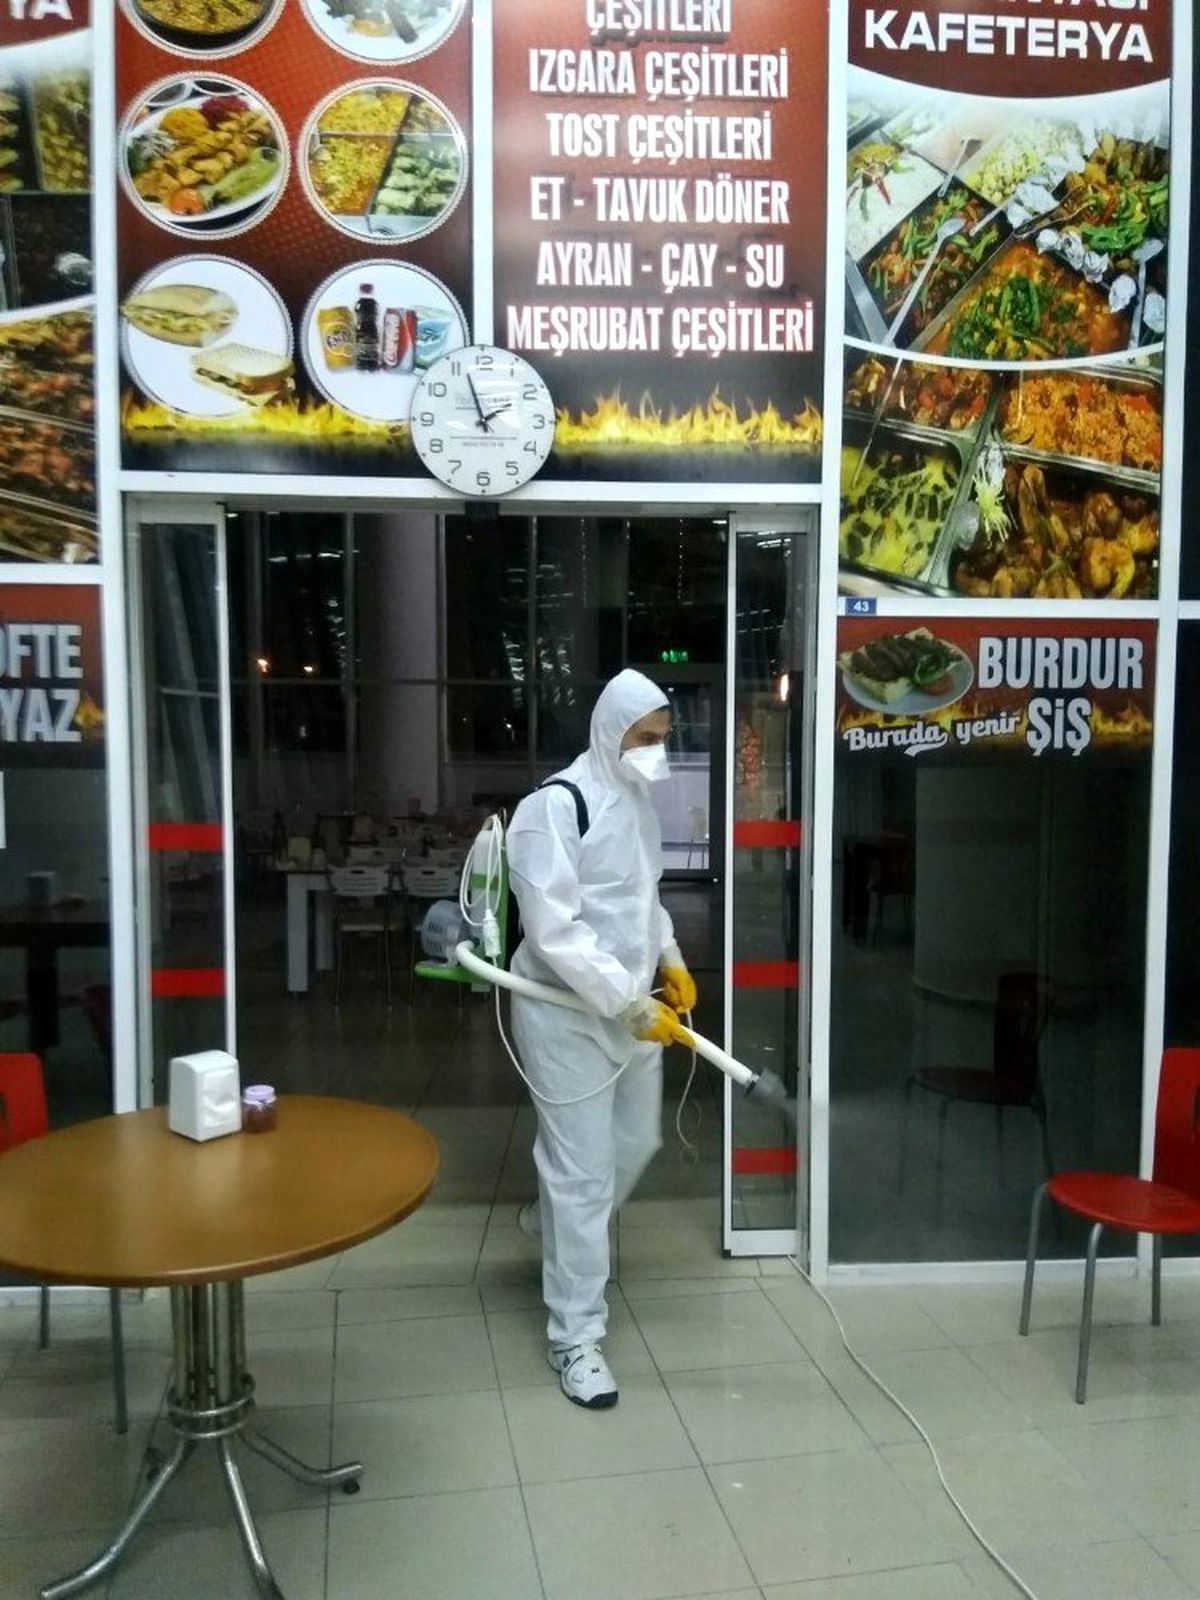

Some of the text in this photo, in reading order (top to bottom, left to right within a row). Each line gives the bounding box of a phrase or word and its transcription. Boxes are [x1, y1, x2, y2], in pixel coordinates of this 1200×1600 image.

[865, 9, 1154, 63] KAFETERYA
[529, 46, 789, 102] IZGARA ÇEŞİTLERİ
[546, 108, 772, 165] TOST ÇEŞİTLERİ
[530, 177, 565, 221] ET
[592, 178, 688, 223] TAVUK
[695, 173, 791, 225] DÖNER
[536, 242, 633, 286] AYRAN
[661, 243, 718, 294] ÇAY
[745, 244, 785, 289] SU
[507, 300, 814, 358] MEŞRUBAT ÇEŞİTLERİ
[428, 382, 447, 398] 10
[522, 383, 538, 400] 2
[420, 412, 434, 427] 9
[532, 413, 545, 430] 3
[430, 438, 443, 453] 8
[522, 440, 537, 456] 4
[448, 460, 462, 475] 7
[505, 461, 519, 476] 5
[476, 472, 491, 487] 6
[853, 600, 869, 612] 43
[978, 637, 1143, 689] BURDUR
[0, 688, 82, 742] YAZ
[842, 712, 1021, 756] Burada yenir
